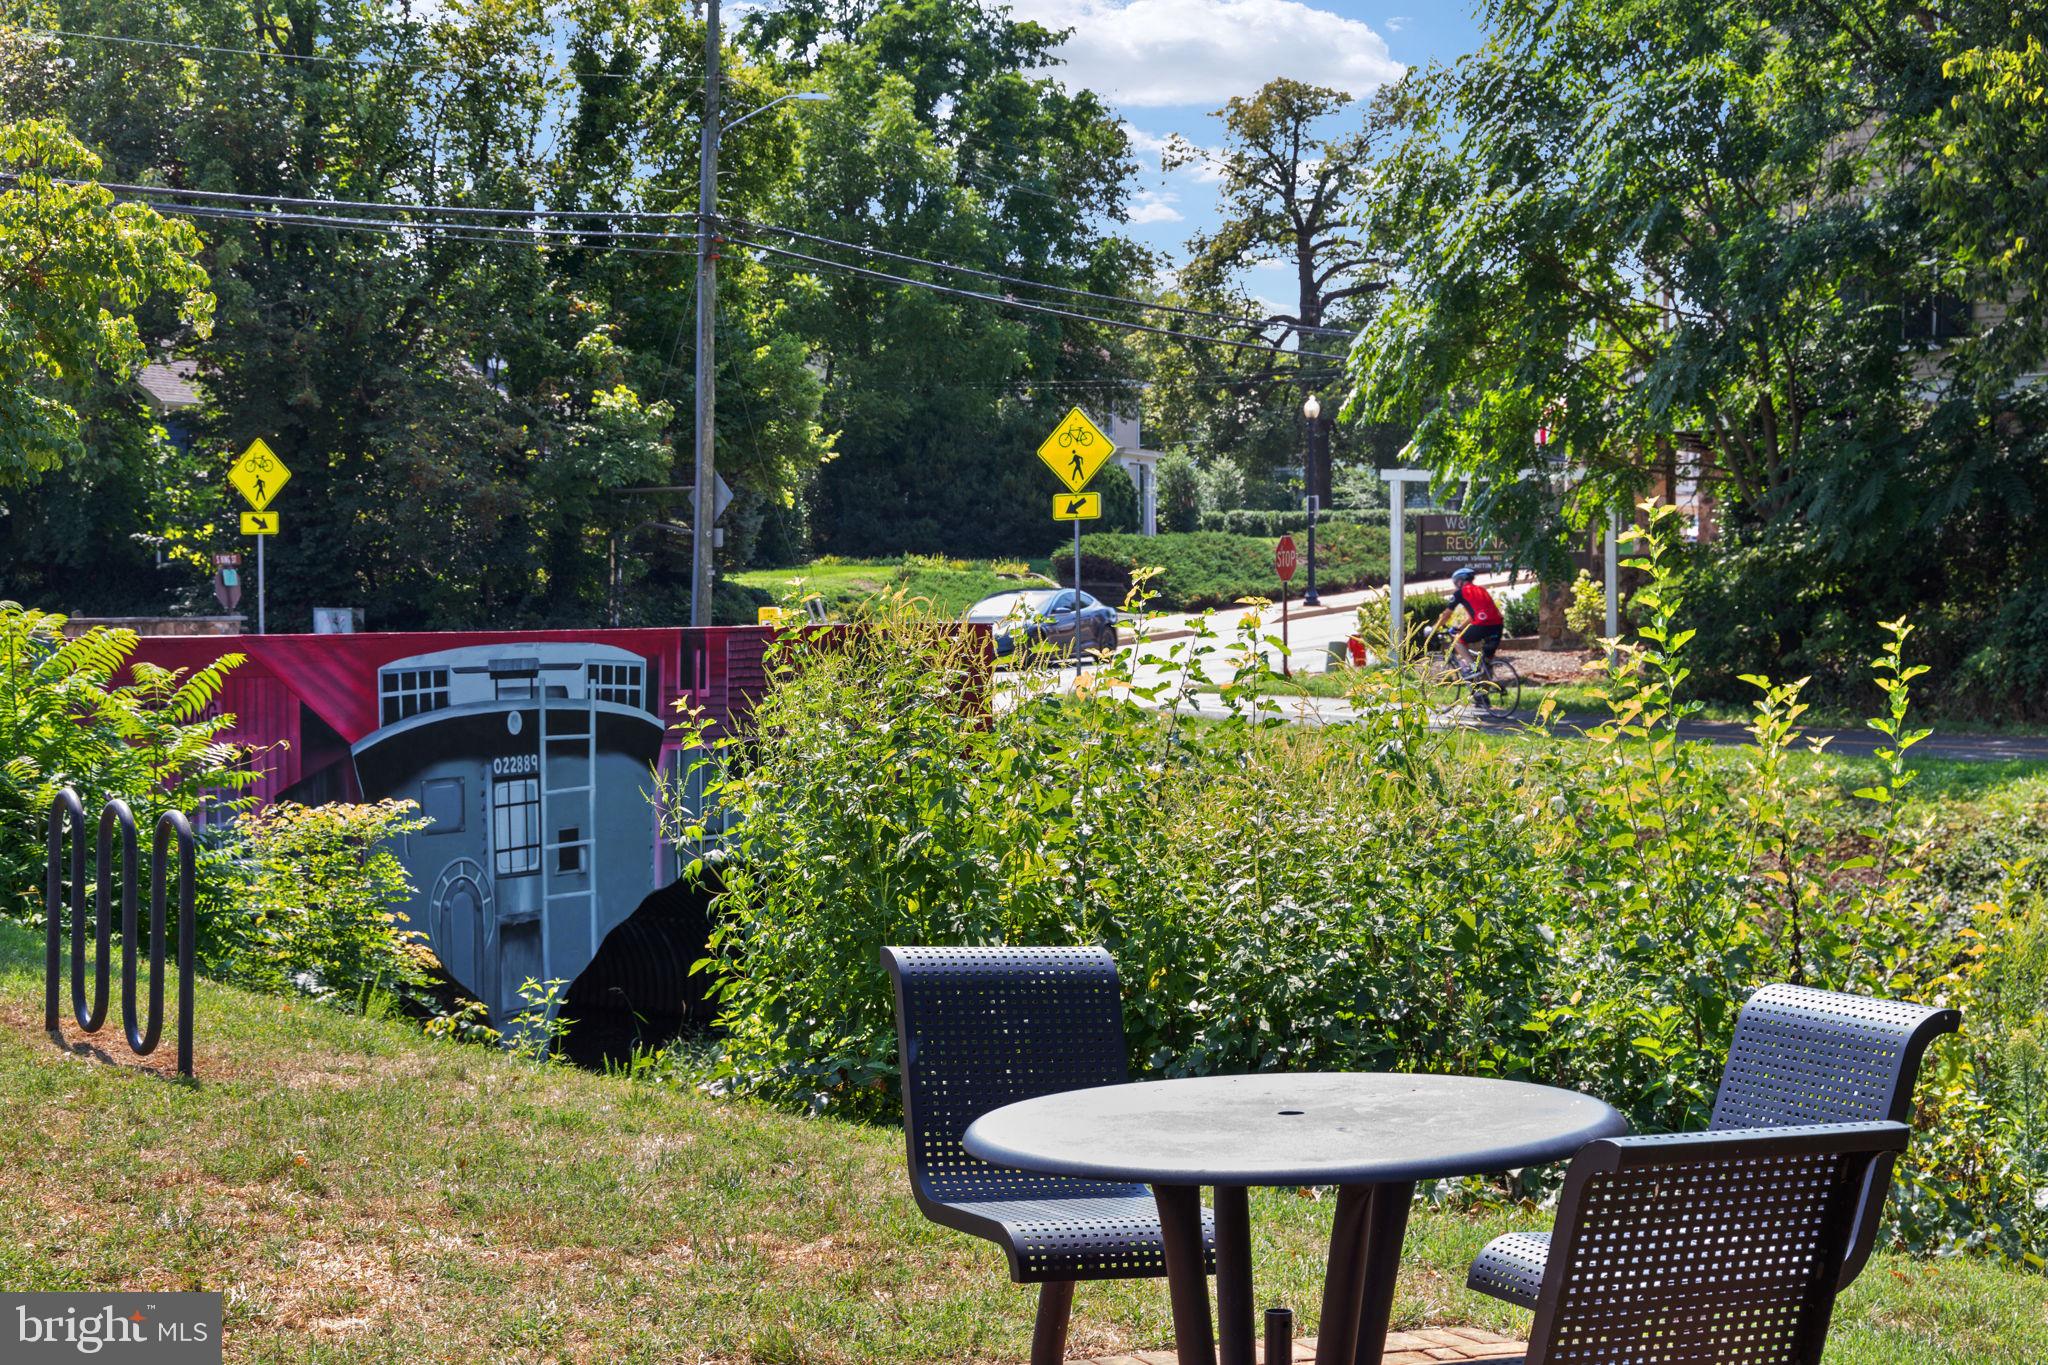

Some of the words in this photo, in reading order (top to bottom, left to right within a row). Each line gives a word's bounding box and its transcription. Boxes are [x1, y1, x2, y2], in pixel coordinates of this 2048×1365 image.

[1446, 535, 1512, 550] REGNA
[1277, 550, 1296, 567] STOP
[493, 754, 538, 775] 022889
